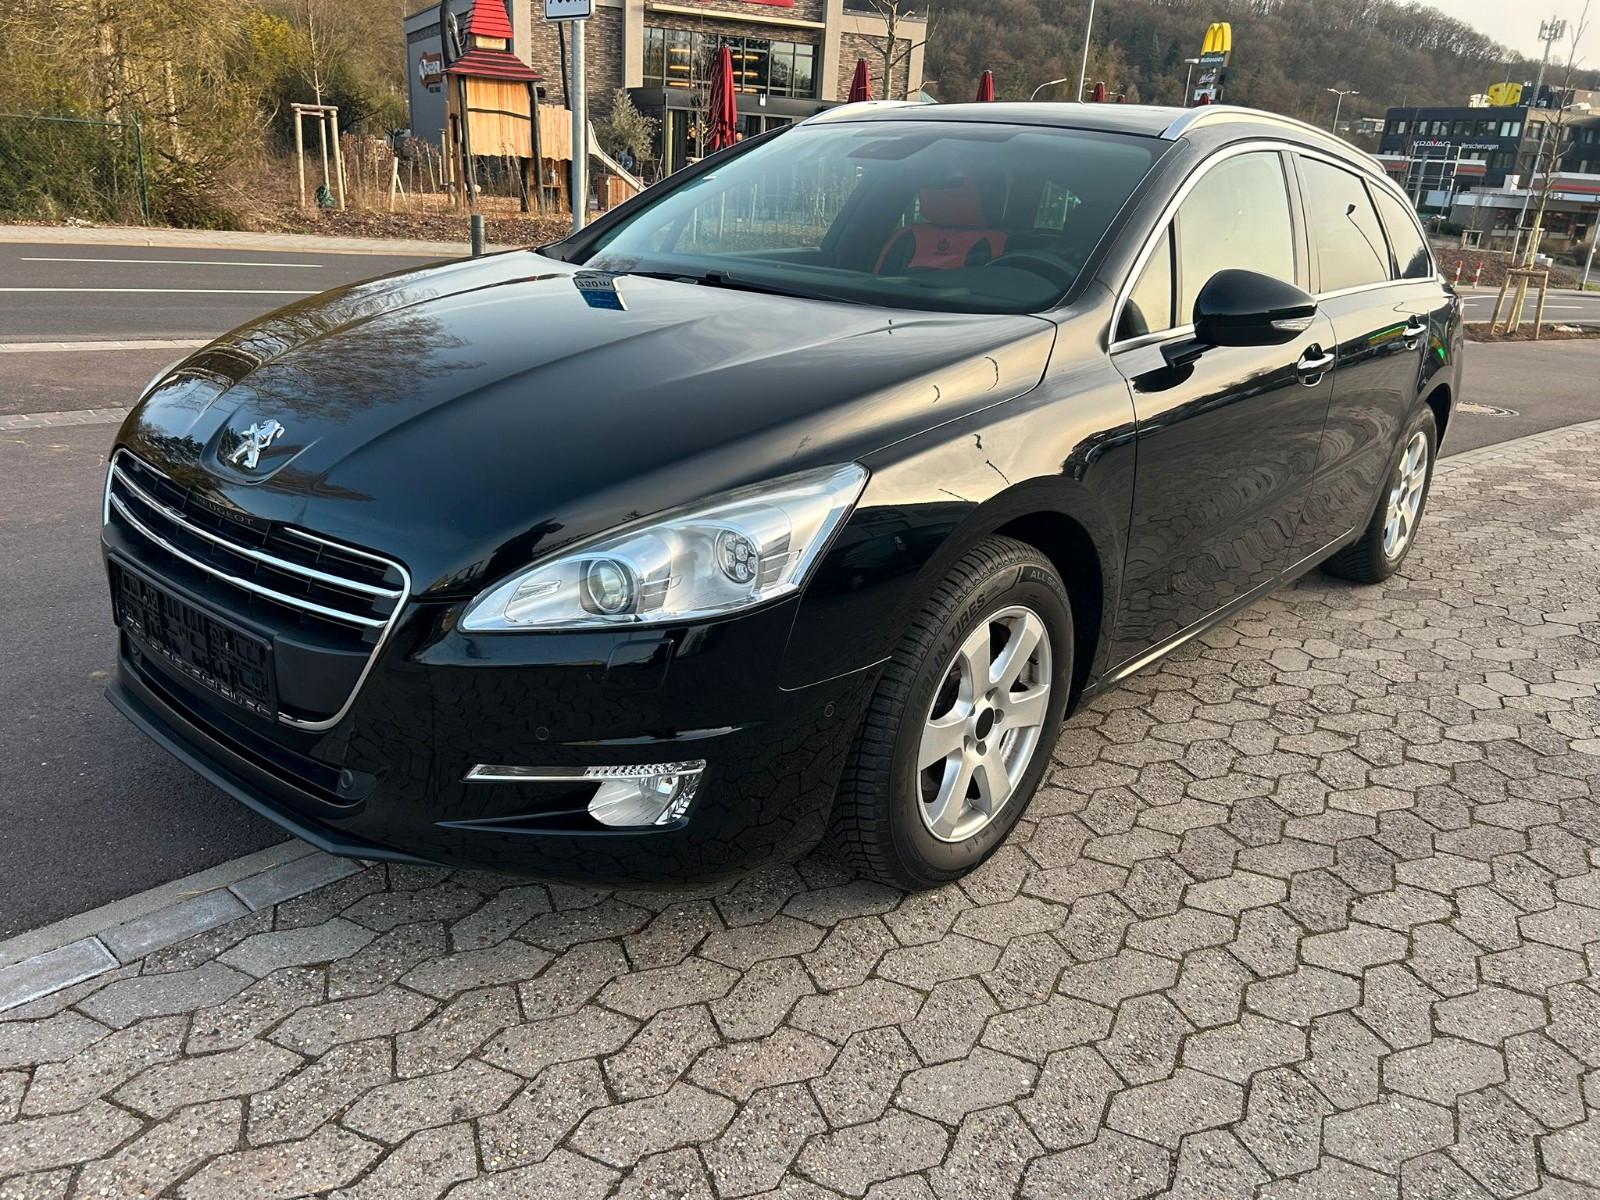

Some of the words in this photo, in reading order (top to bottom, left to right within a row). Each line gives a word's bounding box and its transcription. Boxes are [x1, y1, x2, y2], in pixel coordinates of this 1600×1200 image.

[1461, 142, 1499, 150] Versicherungen
[195, 495, 254, 525] PEUGEOT
[1030, 569, 1047, 582] ALL
[948, 594, 986, 641] TIRES
